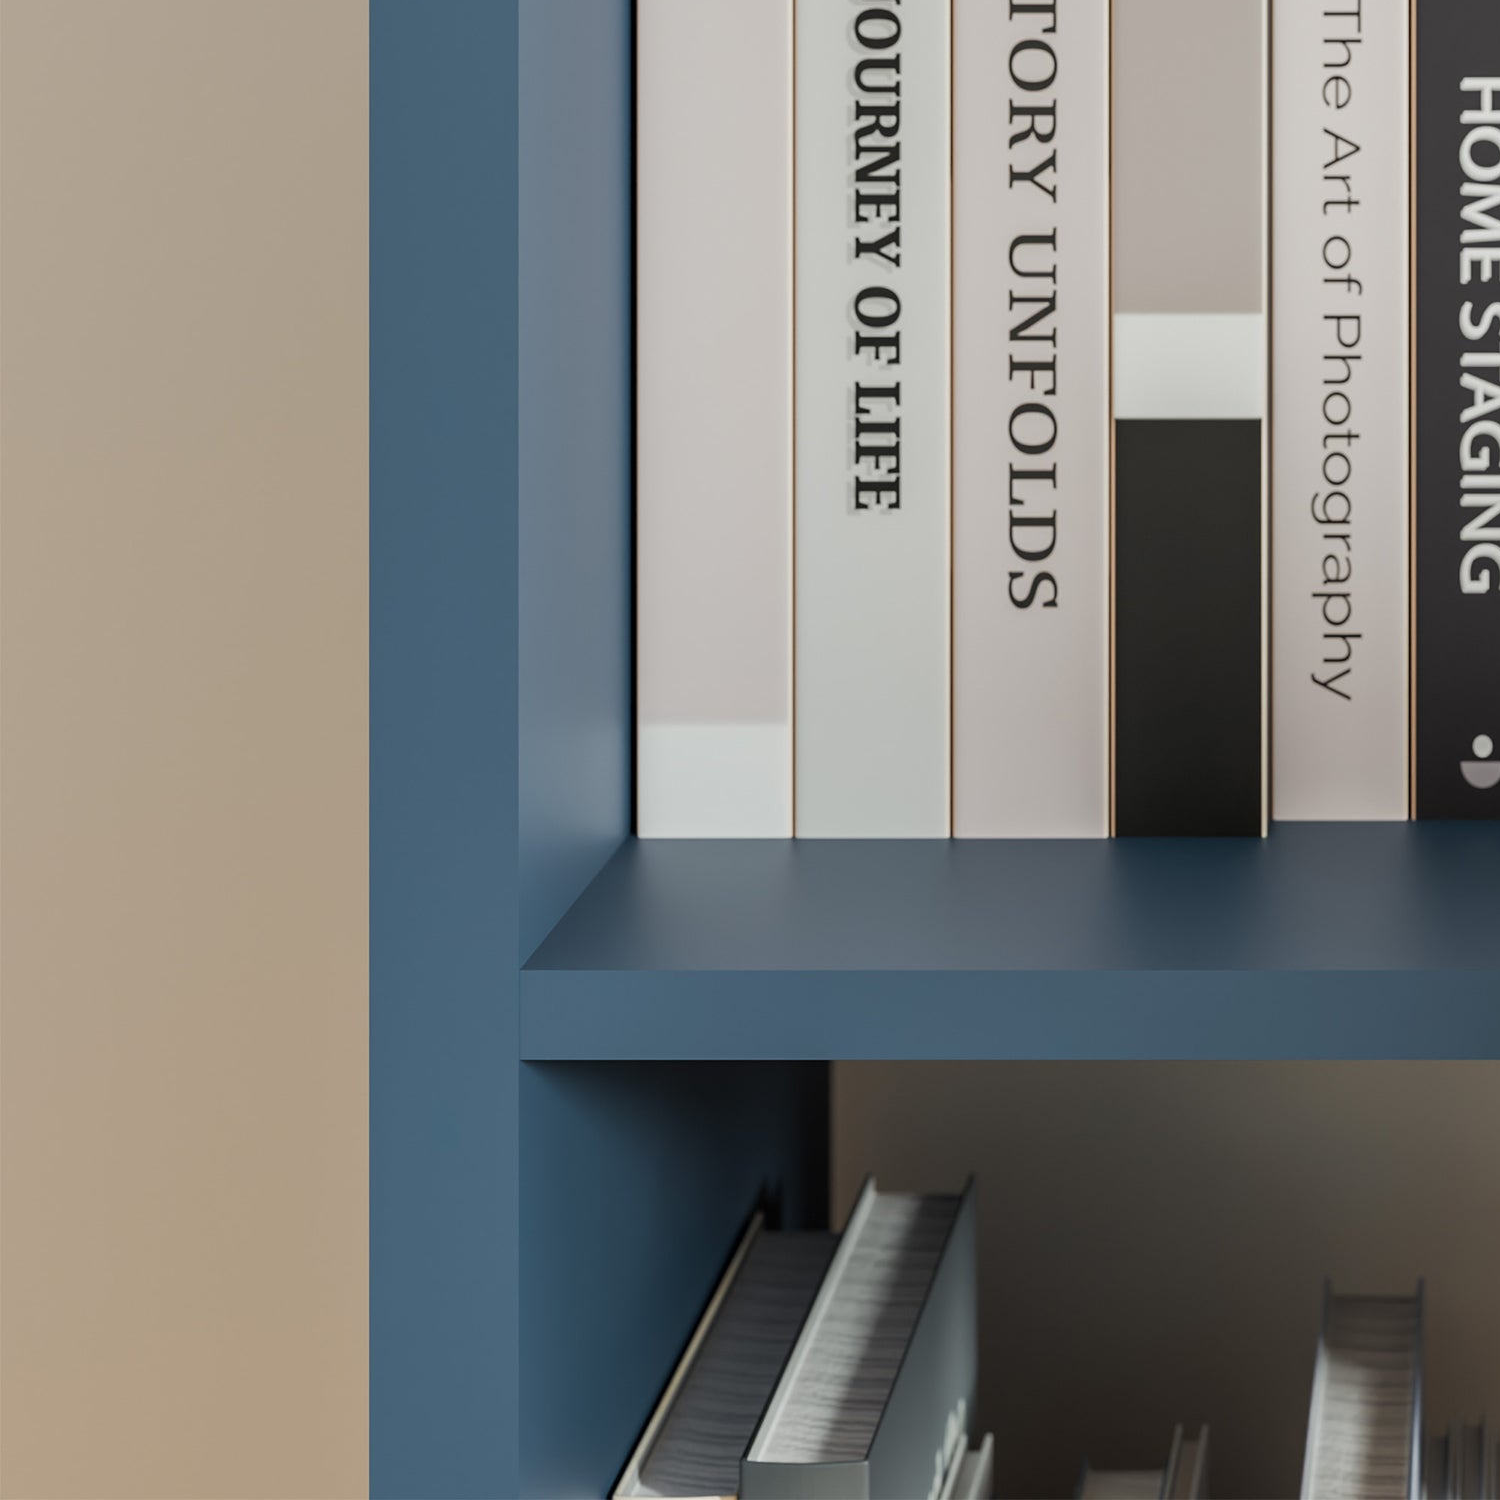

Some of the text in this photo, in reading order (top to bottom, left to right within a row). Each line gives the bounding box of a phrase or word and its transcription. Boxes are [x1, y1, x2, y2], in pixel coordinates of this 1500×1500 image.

[1322, 127, 1362, 216] Art
[1322, 235, 1363, 296] of
[852, 285, 903, 365] OF
[853, 380, 902, 511] LIFE
[1007, 227, 1059, 610] UNFOLDS
[1310, 314, 1363, 702] Photography
